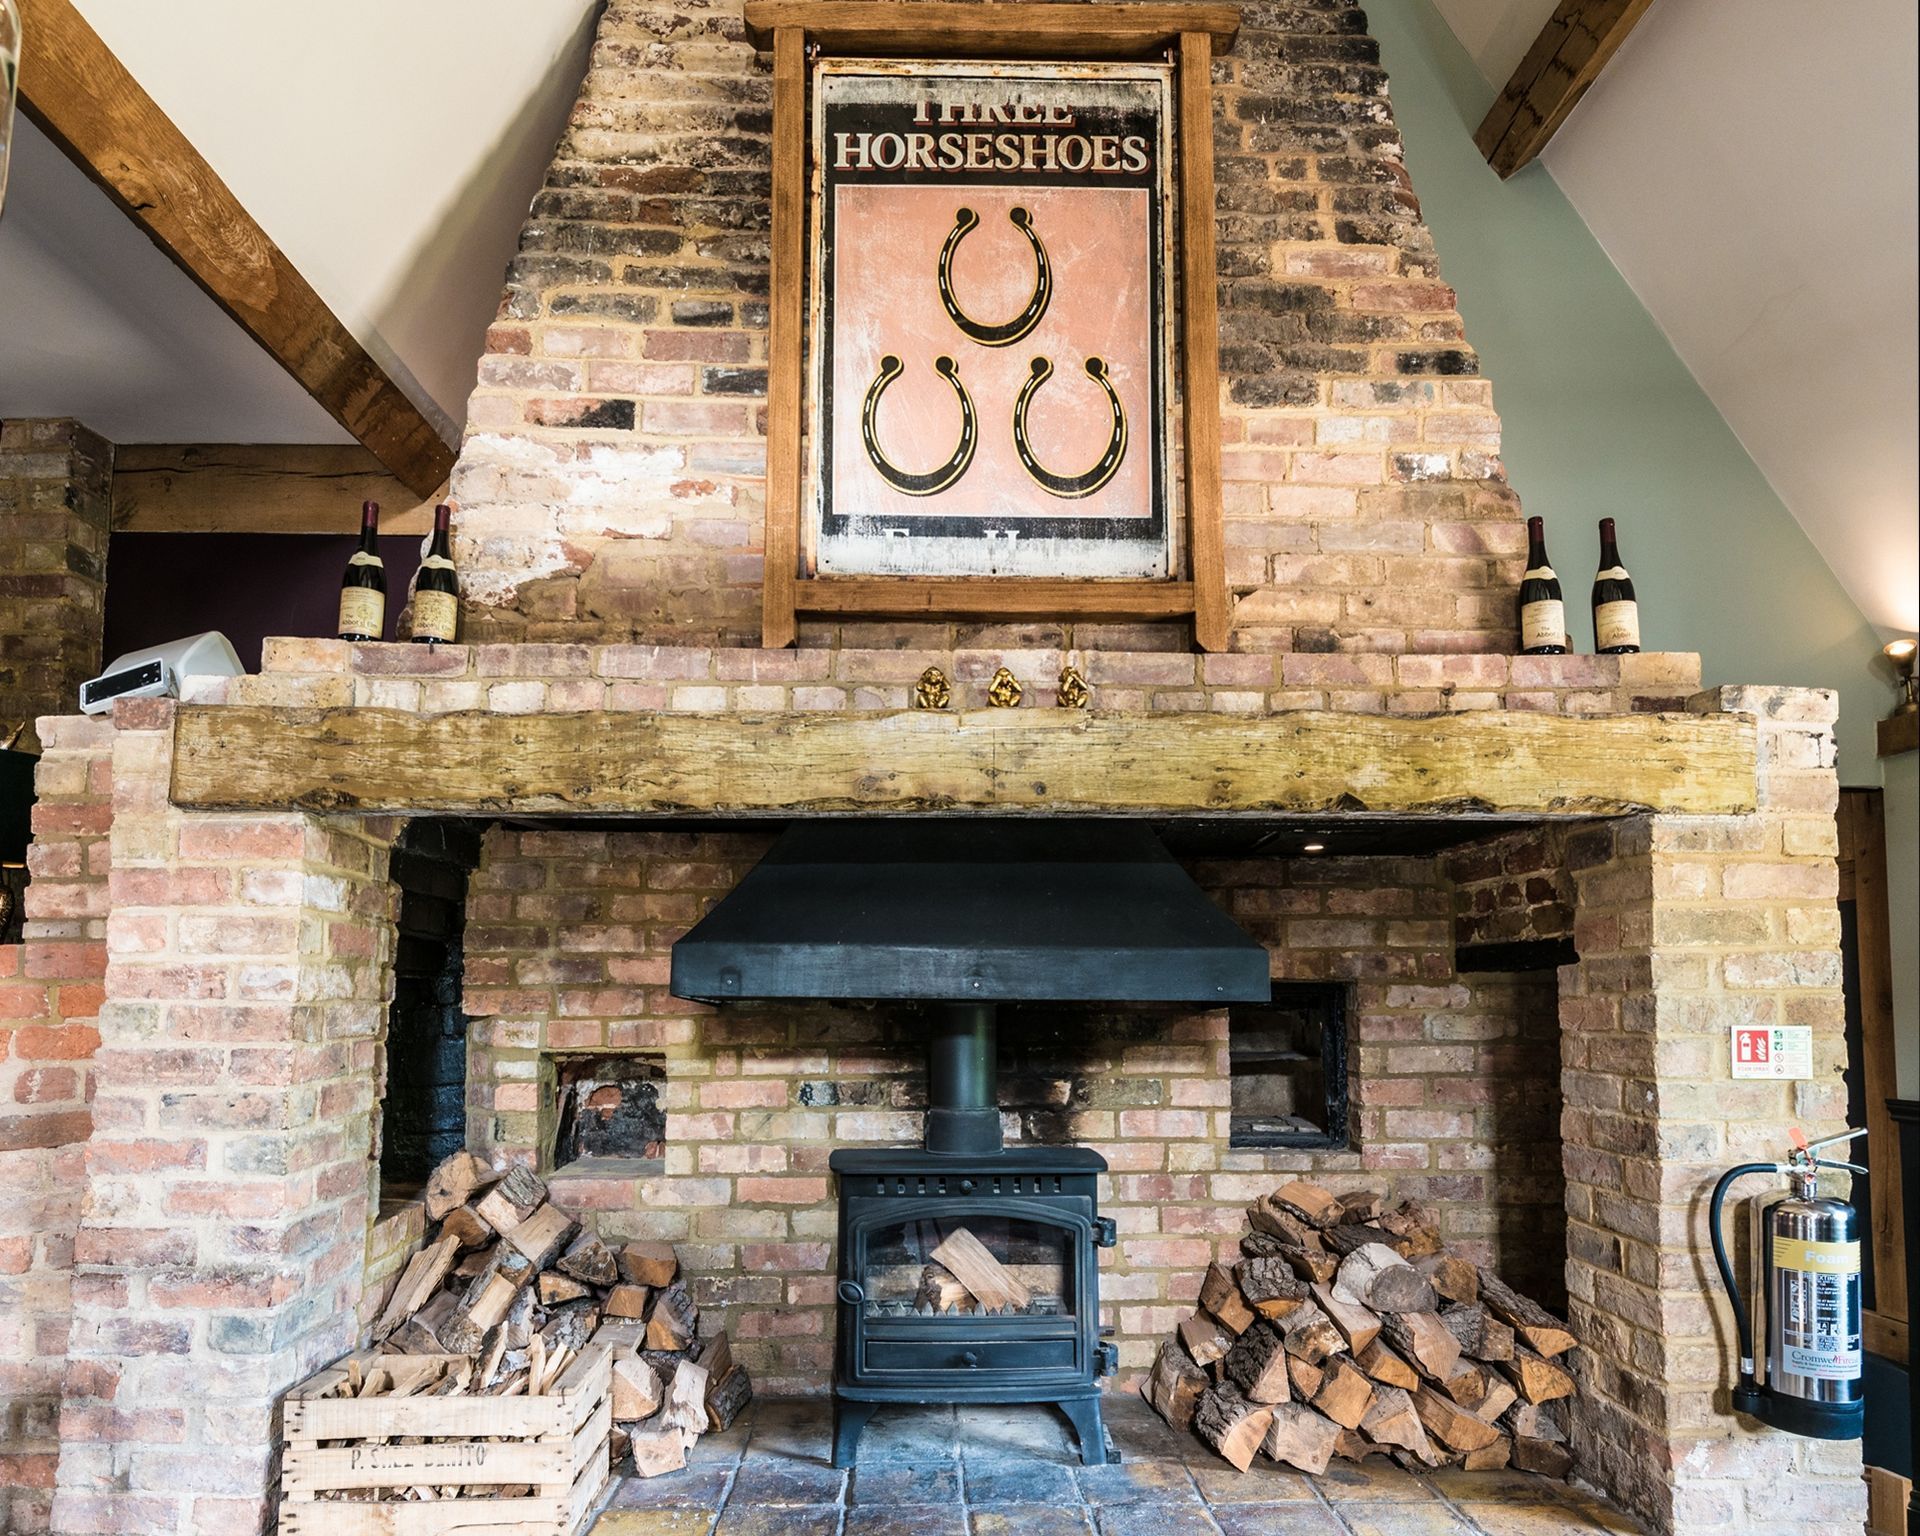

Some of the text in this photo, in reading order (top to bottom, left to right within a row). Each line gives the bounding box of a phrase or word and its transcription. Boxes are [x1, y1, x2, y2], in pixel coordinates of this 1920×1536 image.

[913, 90, 1076, 127] THREE
[833, 132, 1152, 175] HORSESHOES
[1805, 1250, 1849, 1265] Foam
[351, 1447, 364, 1470] P.
